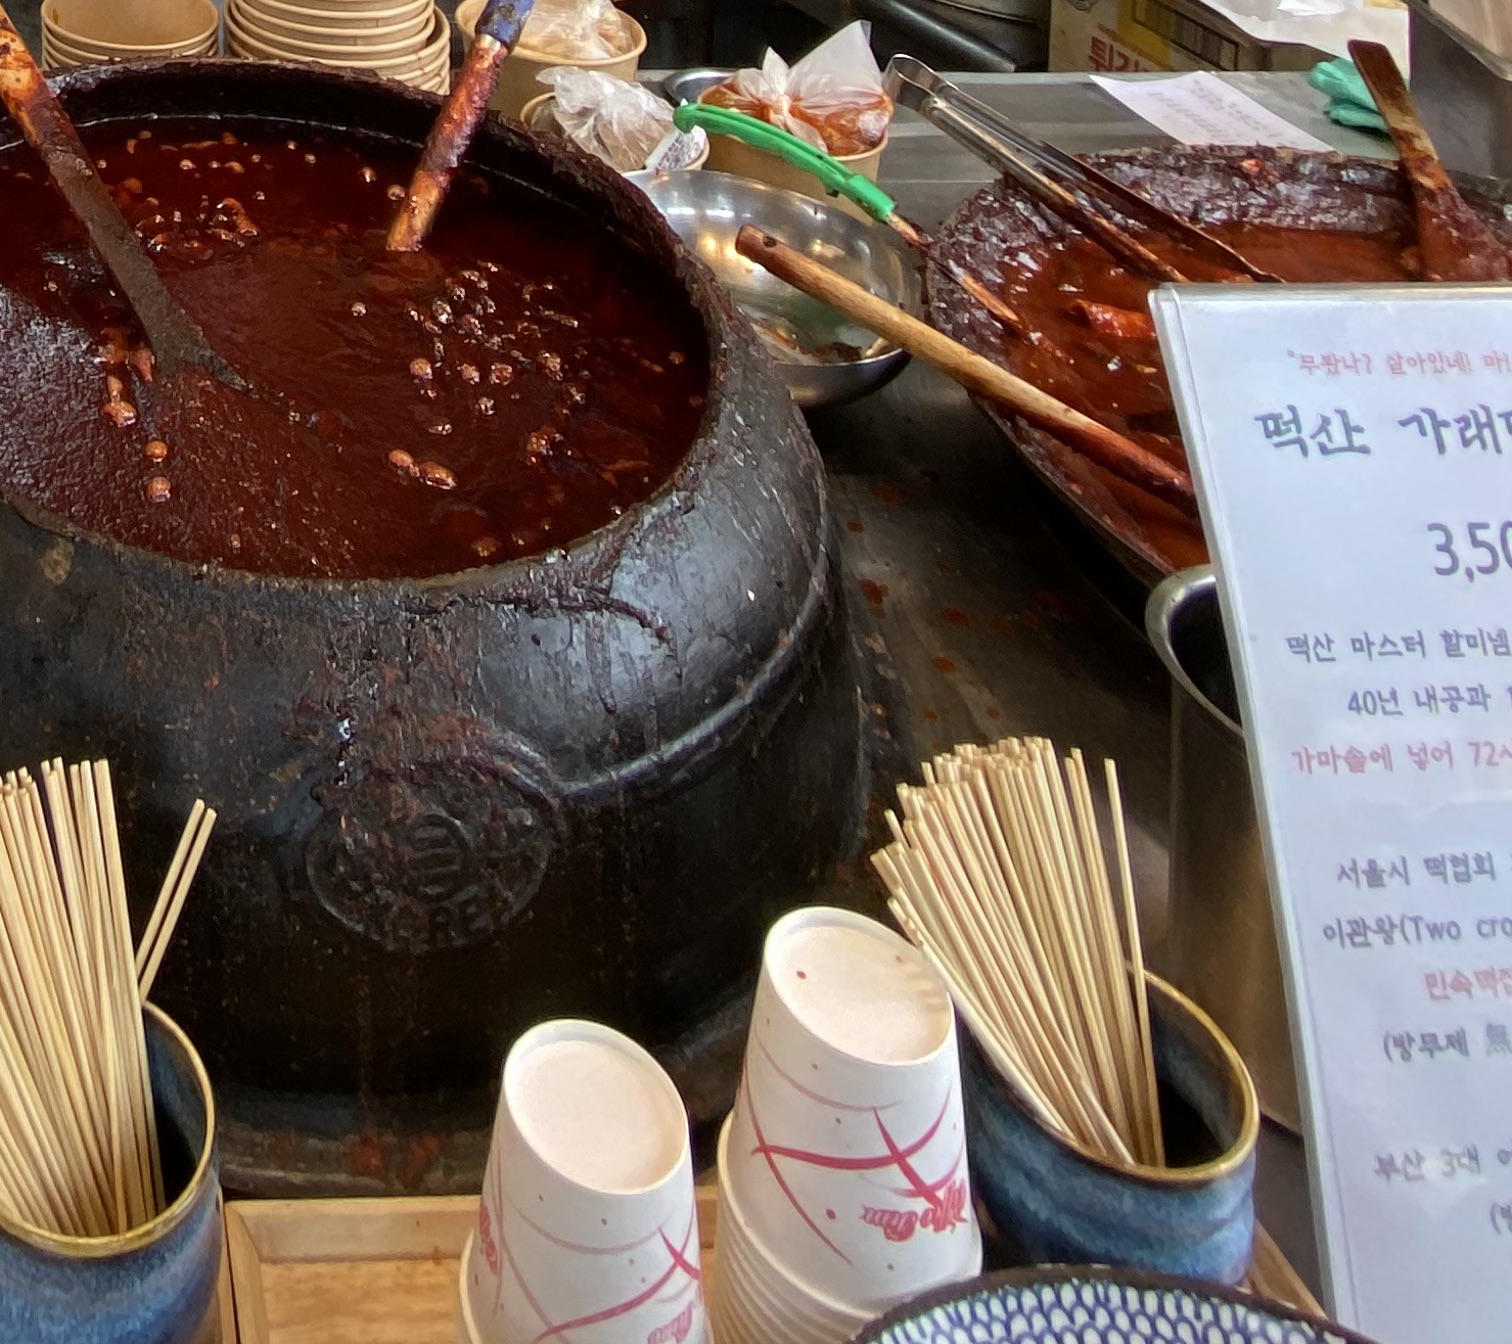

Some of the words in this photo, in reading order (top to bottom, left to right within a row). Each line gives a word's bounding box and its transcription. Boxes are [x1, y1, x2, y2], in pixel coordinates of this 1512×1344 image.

[1255, 404, 1372, 458] 떡산
[1286, 632, 1337, 664] 떡산
[1350, 630, 1428, 662] 마스터
[1348, 686, 1405, 717] 40년
[1414, 683, 1491, 714] 내공과
[1338, 855, 1410, 889] 서울시
